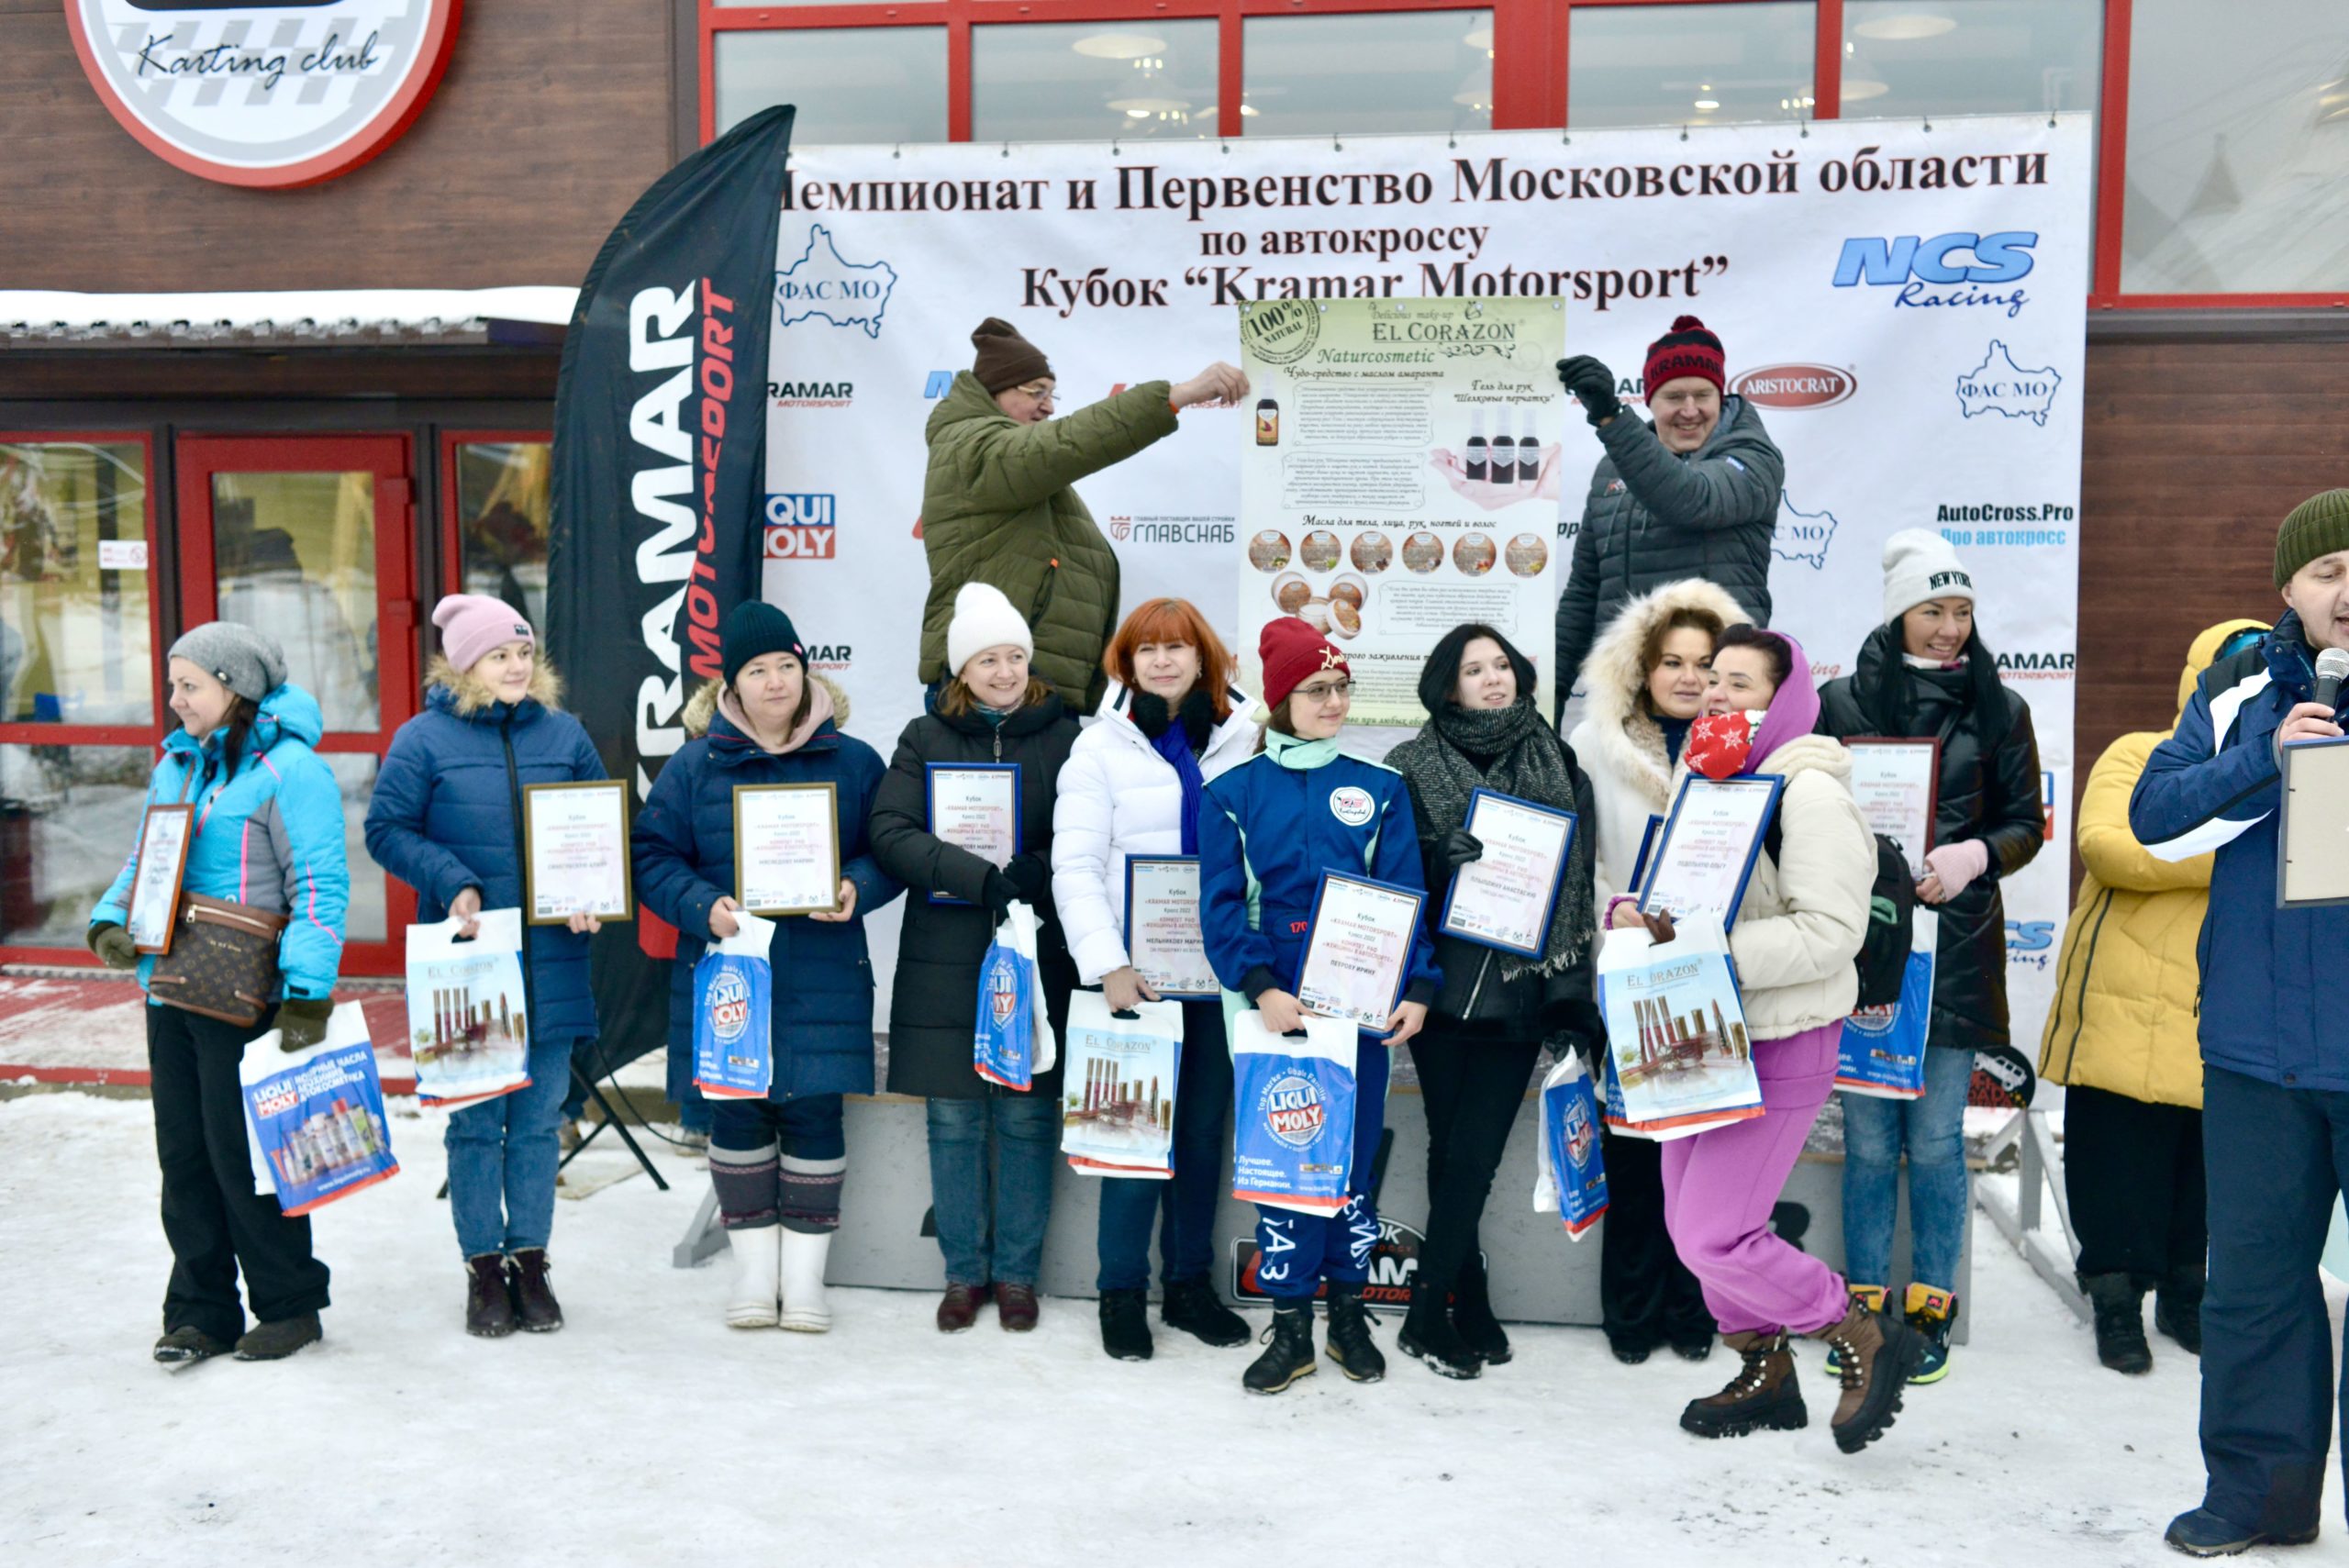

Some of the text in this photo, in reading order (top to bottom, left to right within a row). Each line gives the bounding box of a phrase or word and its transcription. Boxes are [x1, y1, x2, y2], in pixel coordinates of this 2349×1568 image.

[137, 31, 379, 89] Karting club
[1066, 179, 1097, 210] и
[1114, 166, 1433, 222] Первенство
[1450, 150, 1799, 203] Московской
[1819, 146, 2049, 192] области
[1200, 226, 1490, 262] по автокроссу
[1832, 231, 2039, 287] NCS
[780, 280, 880, 300] ФАС МО
[1020, 266, 1169, 318] Кубок
[1894, 281, 2030, 317] Racing
[1249, 301, 1303, 338] 100%
[1264, 321, 1304, 345] NATURAL
[1317, 348, 1436, 365] Naturcosmetic
[1284, 366, 1352, 380] Чудо-средство
[1361, 370, 1395, 378] маслом
[1397, 369, 1445, 380] амаранта
[766, 382, 853, 398] RAMAR
[1471, 380, 1534, 393] Гель для рук
[1744, 375, 1840, 395] ARISTOCRAT
[1961, 380, 2048, 398] ФАС МО
[777, 400, 853, 408] MOTORSPORT
[765, 495, 832, 527] QUI
[1937, 504, 2075, 523] AutoCross.Pro
[1302, 514, 1335, 527] Масла
[1337, 517, 1353, 526] для
[1355, 519, 1378, 528] тела,
[1381, 519, 1406, 528] лица,
[1430, 518, 1462, 528] ногтей
[1472, 520, 1497, 528] волос
[629, 279, 698, 804] RAMAR
[1133, 524, 1235, 543] ГЛАВСНАБ
[1790, 526, 1824, 541] МО
[1976, 529, 2066, 548] автокросс
[1929, 571, 1950, 590] NEW
[803, 646, 852, 662] MAR
[1368, 652, 1421, 662] заживления
[1995, 653, 2075, 670] AMAR
[1168, 888, 1186, 896] Кубок
[1357, 912, 1375, 922] Кубок
[2005, 921, 2054, 951] CS
[253, 1079, 293, 1103] LIQUI
[1257, 1098, 1267, 1111] Top
[1262, 1074, 1282, 1096] Marke
[1269, 1085, 1318, 1111] LIQUI
[258, 1092, 298, 1117] MOLY
[1272, 1106, 1323, 1132] MOLY
[1239, 1154, 1274, 1167] Лучшее.
[1238, 1165, 1286, 1178] Настоящее.
[1237, 1177, 1293, 1190] Из Германии.
